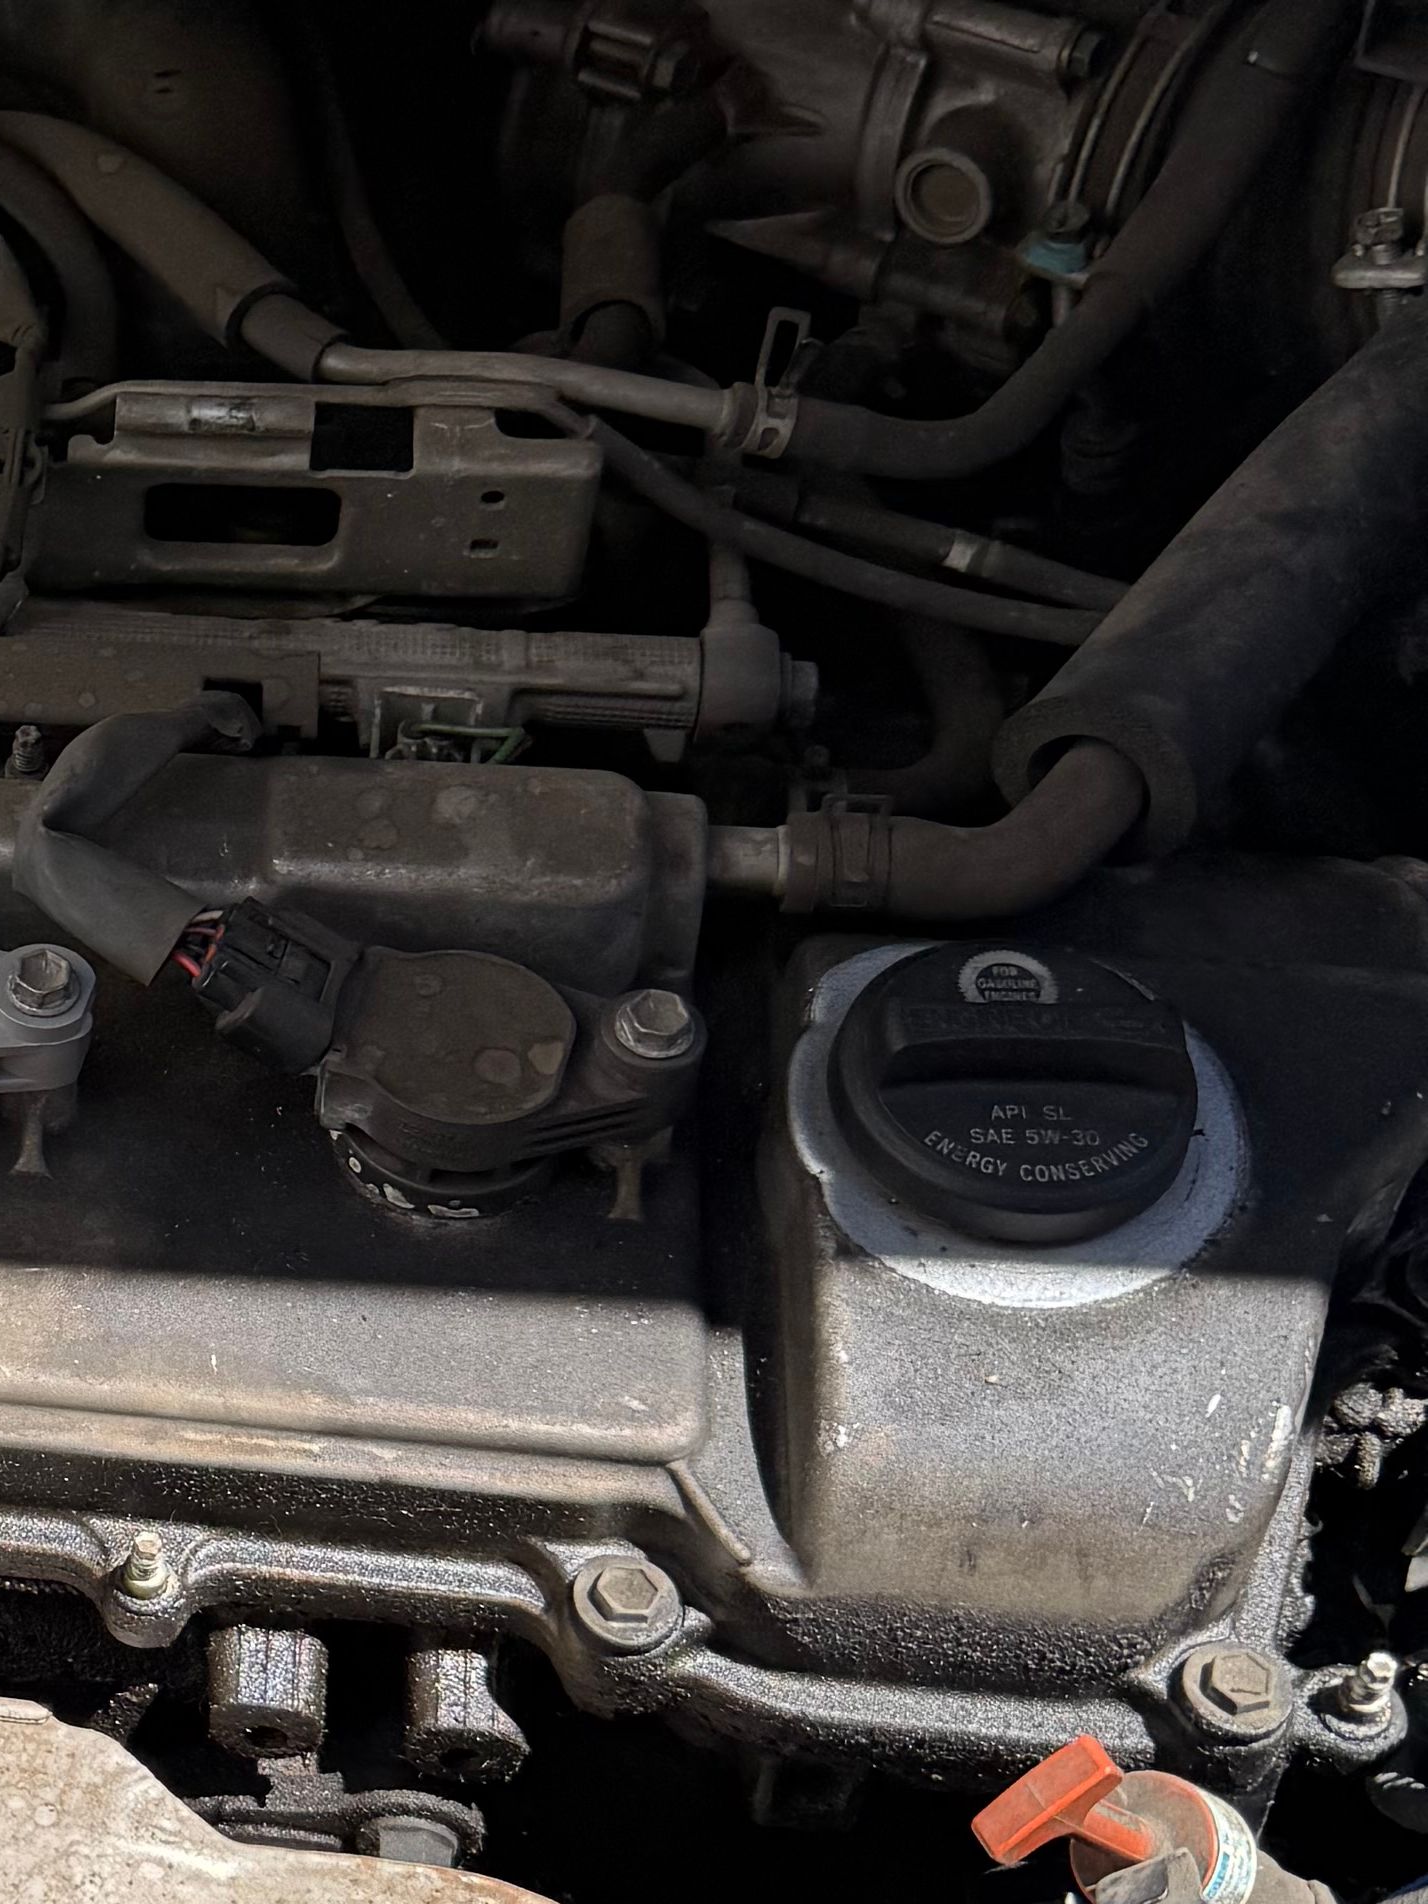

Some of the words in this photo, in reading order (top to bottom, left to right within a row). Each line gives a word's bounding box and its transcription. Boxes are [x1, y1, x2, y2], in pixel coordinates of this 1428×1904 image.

[976, 977, 1038, 989] GASOLINE
[990, 1104, 1027, 1121] API
[1042, 1104, 1073, 1122] SL
[968, 1127, 1016, 1145] SAE
[1025, 1128, 1101, 1146] 5W-30
[923, 1129, 1008, 1177] ENERGY
[1019, 1130, 1150, 1184] CONSERVING
